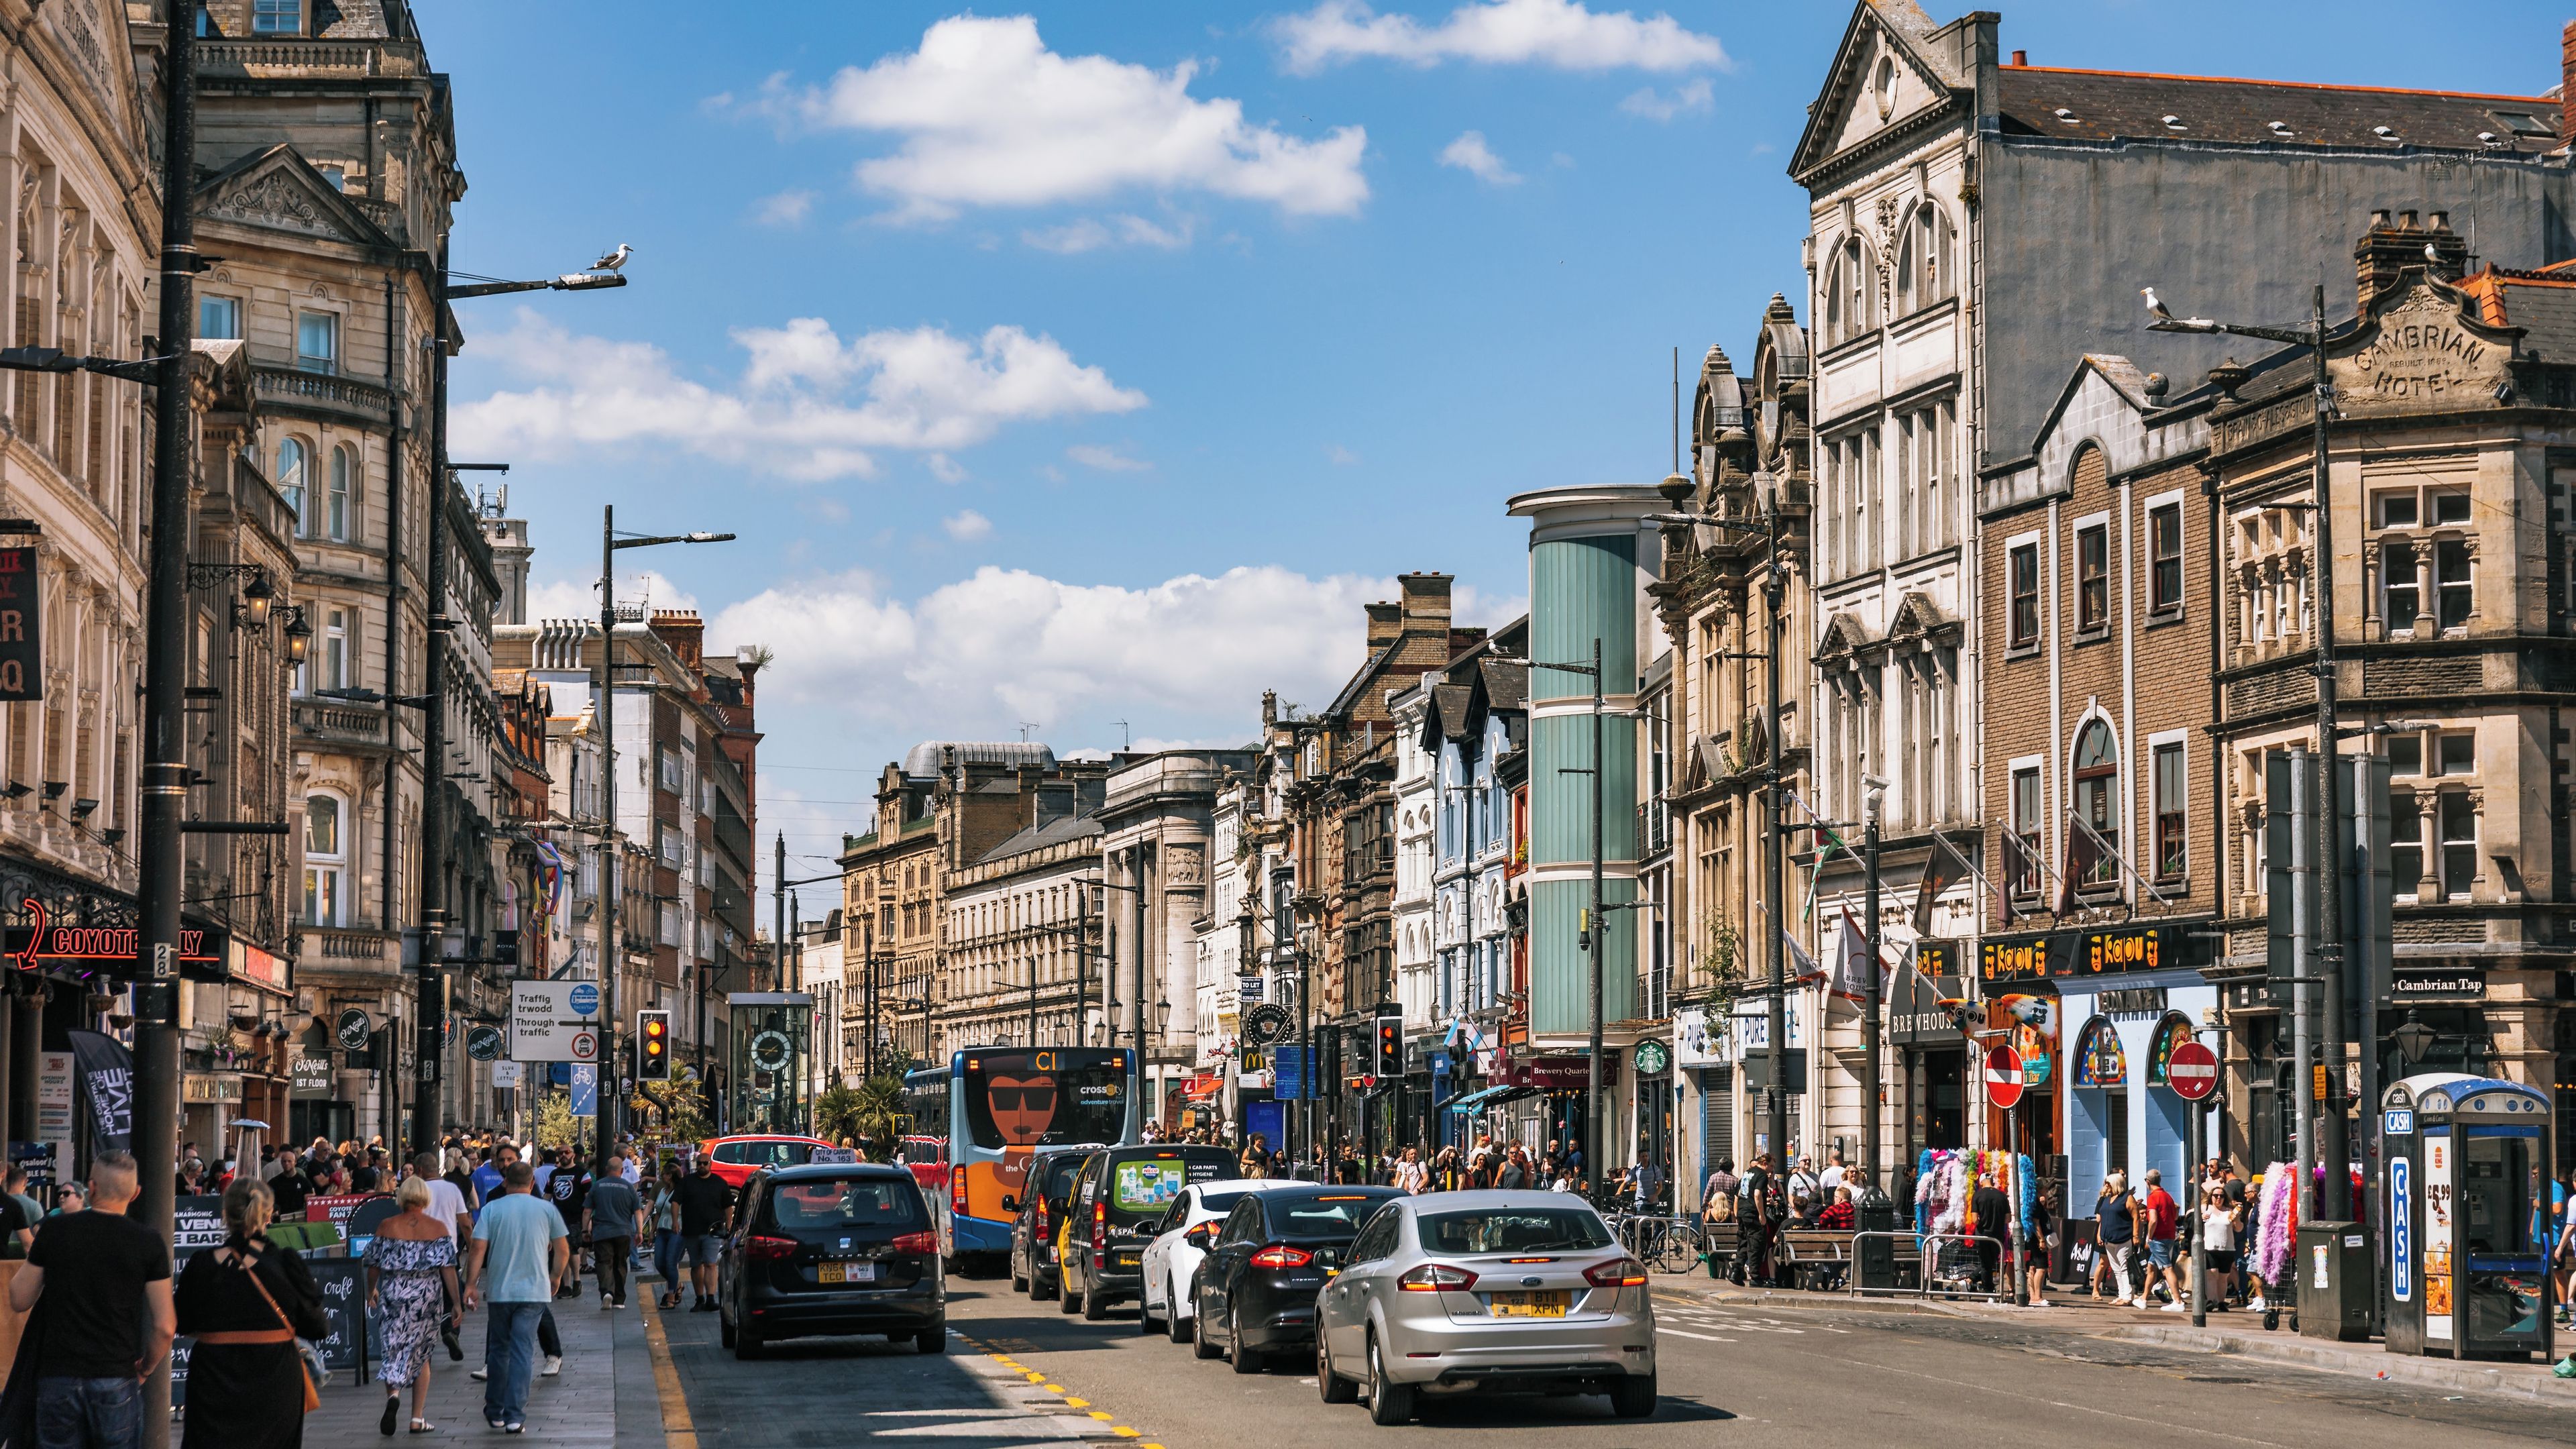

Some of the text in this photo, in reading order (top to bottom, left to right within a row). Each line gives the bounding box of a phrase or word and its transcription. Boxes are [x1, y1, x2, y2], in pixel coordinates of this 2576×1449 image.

[2374, 369, 2463, 396] HOTEL
[178, 930, 203, 955] LY
[157, 945, 167, 976] 28
[1844, 982, 1866, 992] HOUS
[2398, 978, 2482, 992] Cambrian Tap
[519, 995, 551, 1004] Traffig
[2259, 988, 2268, 1000] Th
[518, 1005, 552, 1013] trwodd
[515, 1018, 555, 1028] Through
[1892, 1012, 1957, 1033] BREWHOUS
[520, 1028, 550, 1036] traffic
[1745, 1018, 1765, 1044] PURE
[295, 1059, 329, 1076] O'Neill's
[425, 1062, 432, 1079] 26
[1534, 1067, 1591, 1076] Brewery Quarte
[296, 1078, 327, 1087] 1ST FLOOR
[103, 1067, 131, 1135] LIVE
[2392, 1091, 2406, 1104] cash
[2387, 1112, 2410, 1131] CASH
[2428, 1184, 2451, 1212] £5.99
[329, 1211, 346, 1219] FAN
[2070, 1242, 2092, 1262] Asahi
[820, 1264, 845, 1273] KN64
[1534, 1303, 1559, 1314] XPN
